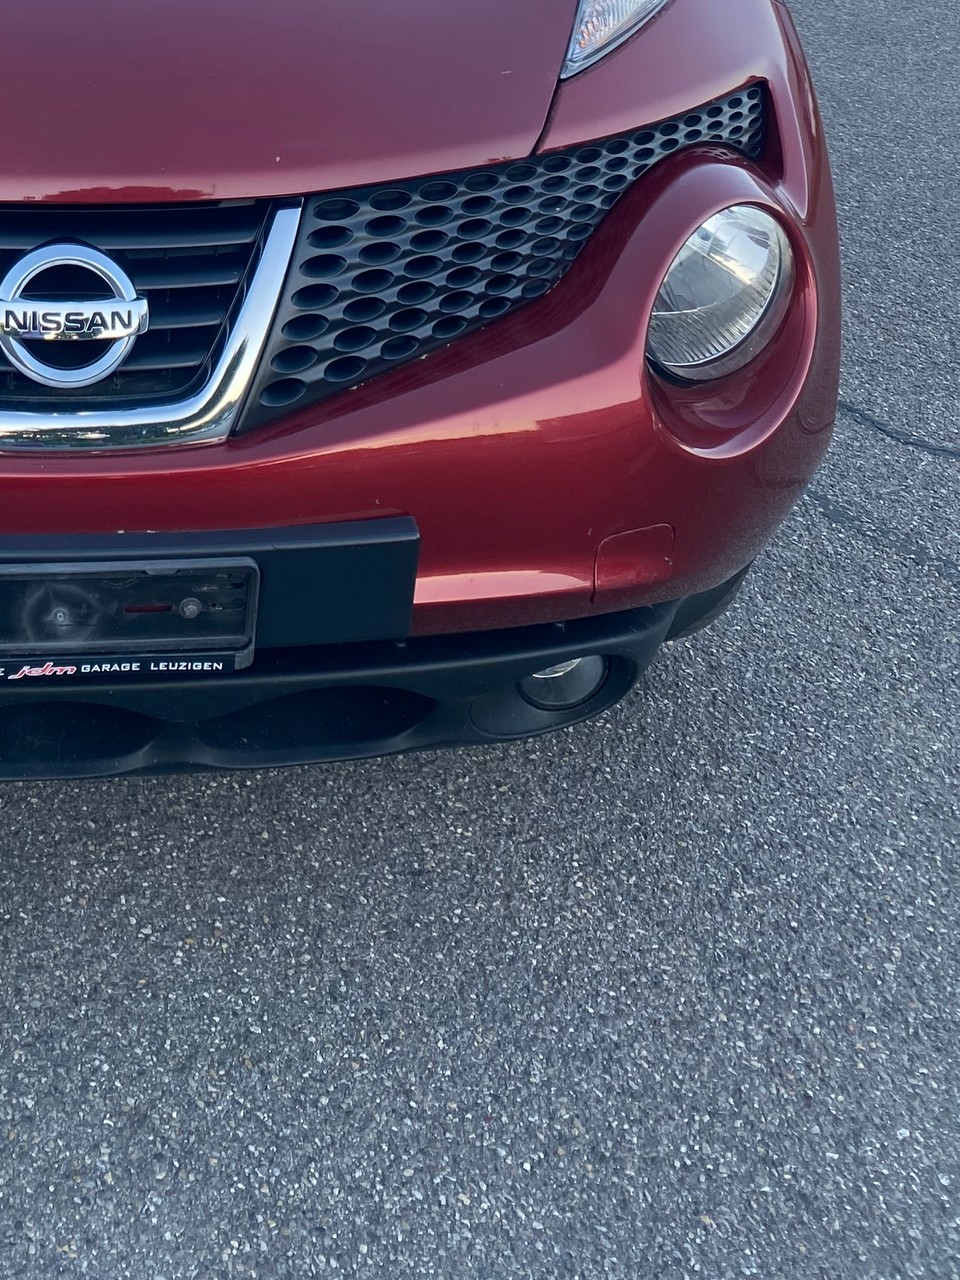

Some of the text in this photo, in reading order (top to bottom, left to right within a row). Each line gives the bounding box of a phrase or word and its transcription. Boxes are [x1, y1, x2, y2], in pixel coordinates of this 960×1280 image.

[4, 309, 133, 332] NISSAN
[81, 662, 141, 673] GARAGE
[150, 662, 224, 671] LEUZIGEN
